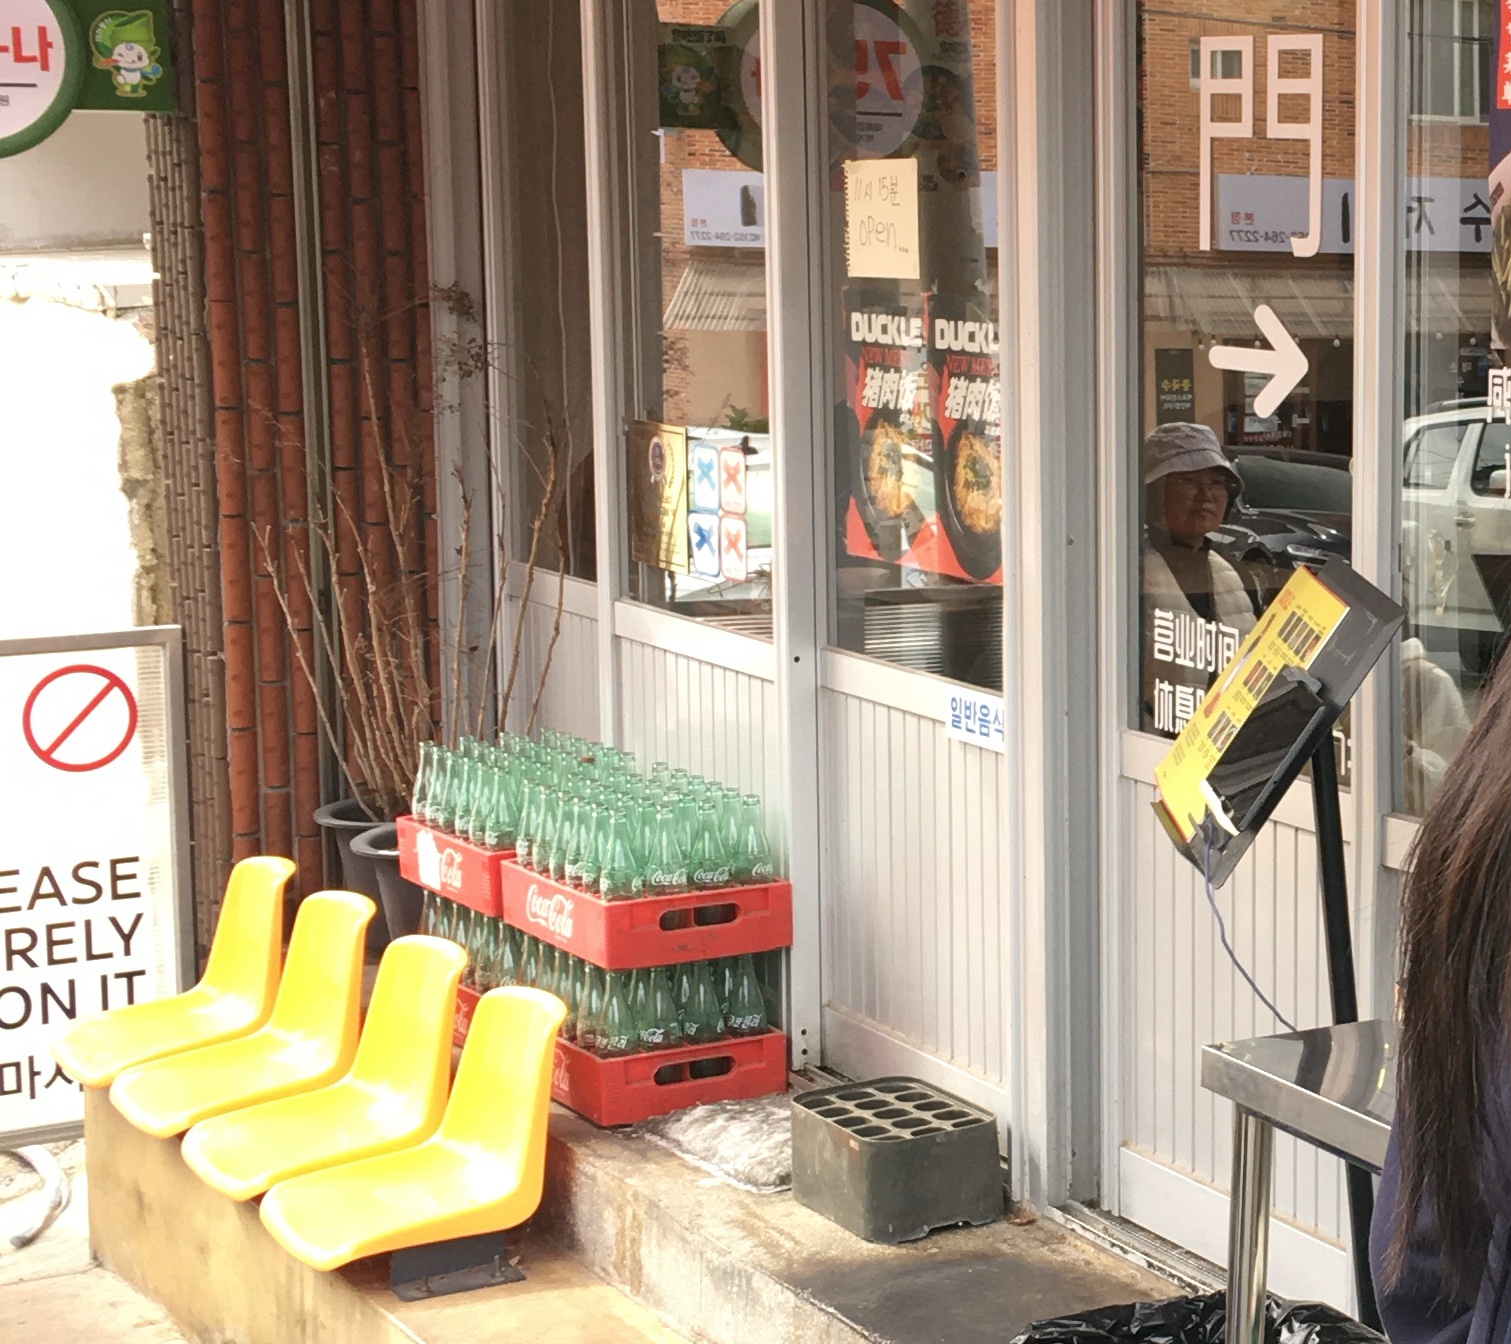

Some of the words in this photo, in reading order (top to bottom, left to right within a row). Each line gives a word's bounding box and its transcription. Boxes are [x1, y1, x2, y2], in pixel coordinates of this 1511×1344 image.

[0, 25, 53, 72] 나
[851, 311, 923, 348] DUCKLE
[1153, 677, 1205, 734] 休息
[0, 856, 141, 912] EASE
[4, 912, 144, 971] RELY
[0, 978, 78, 1032] ON
